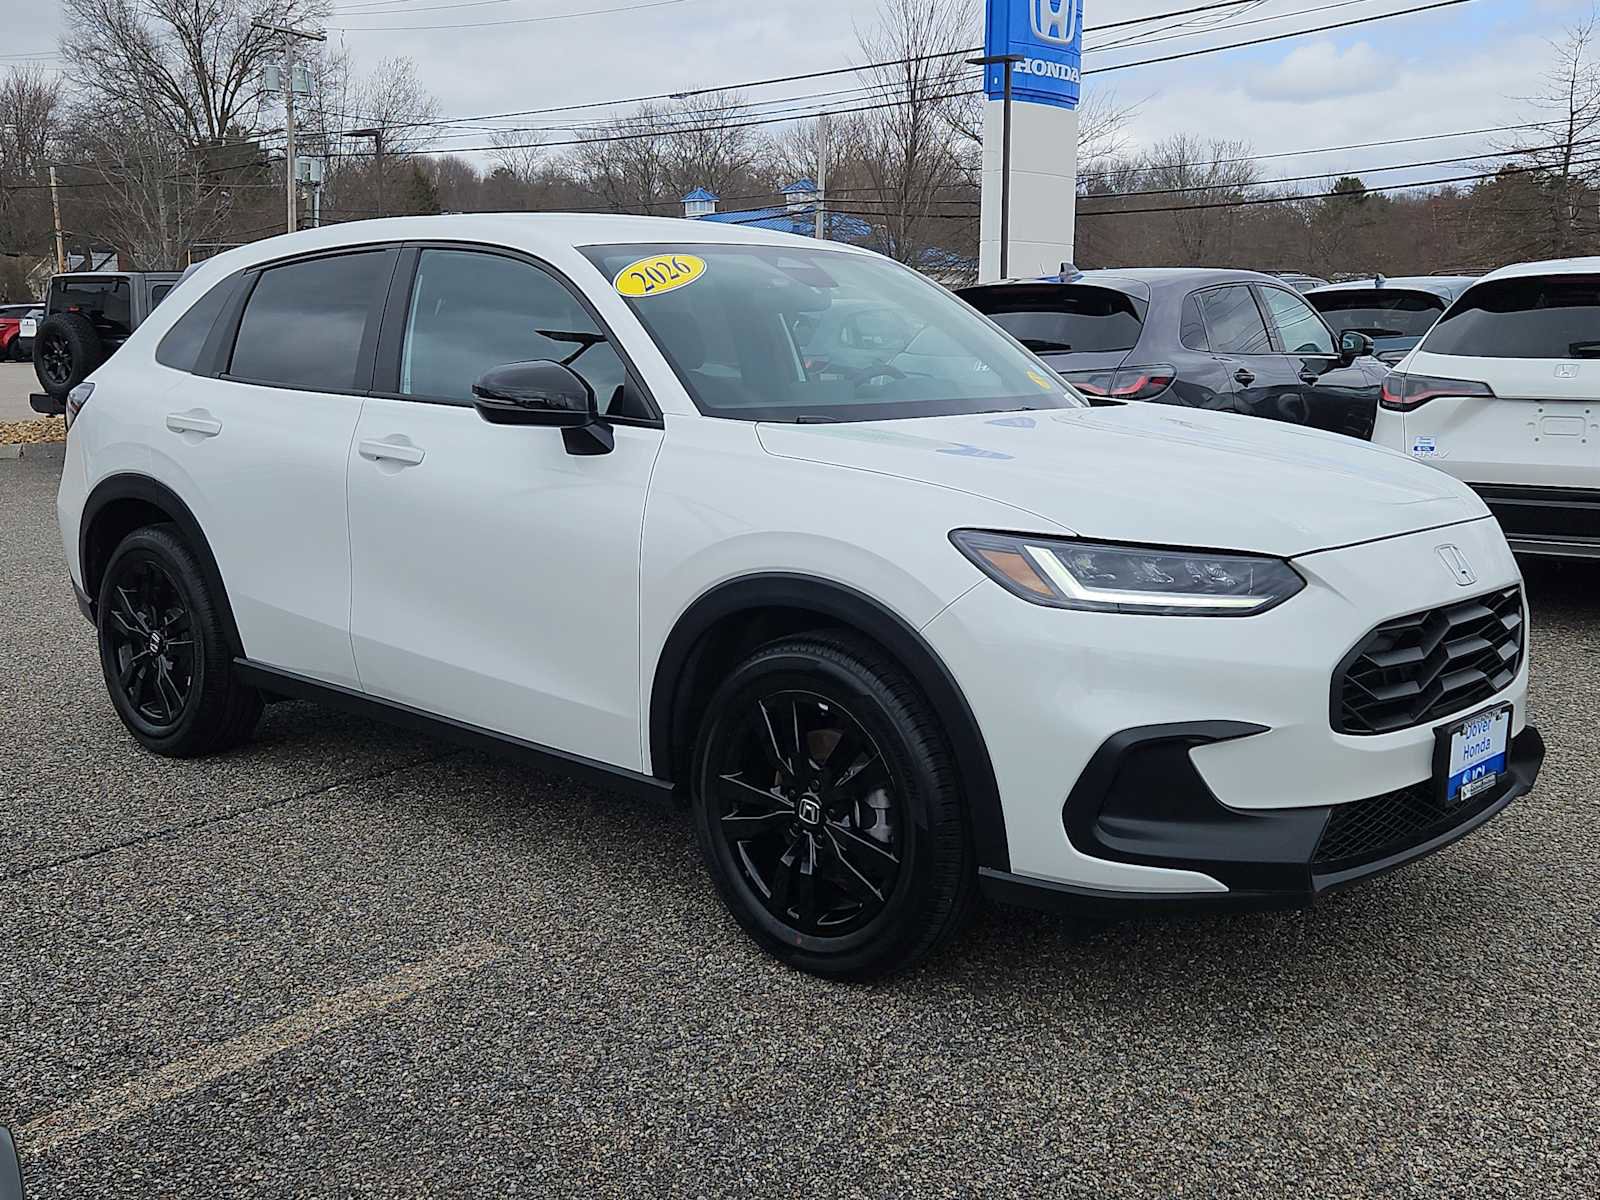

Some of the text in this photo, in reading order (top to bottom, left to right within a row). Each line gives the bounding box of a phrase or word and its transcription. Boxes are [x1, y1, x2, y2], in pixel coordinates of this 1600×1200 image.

[1013, 58, 1080, 83] HONDA
[630, 257, 691, 292] 2026
[1463, 737, 1491, 760] Honda
